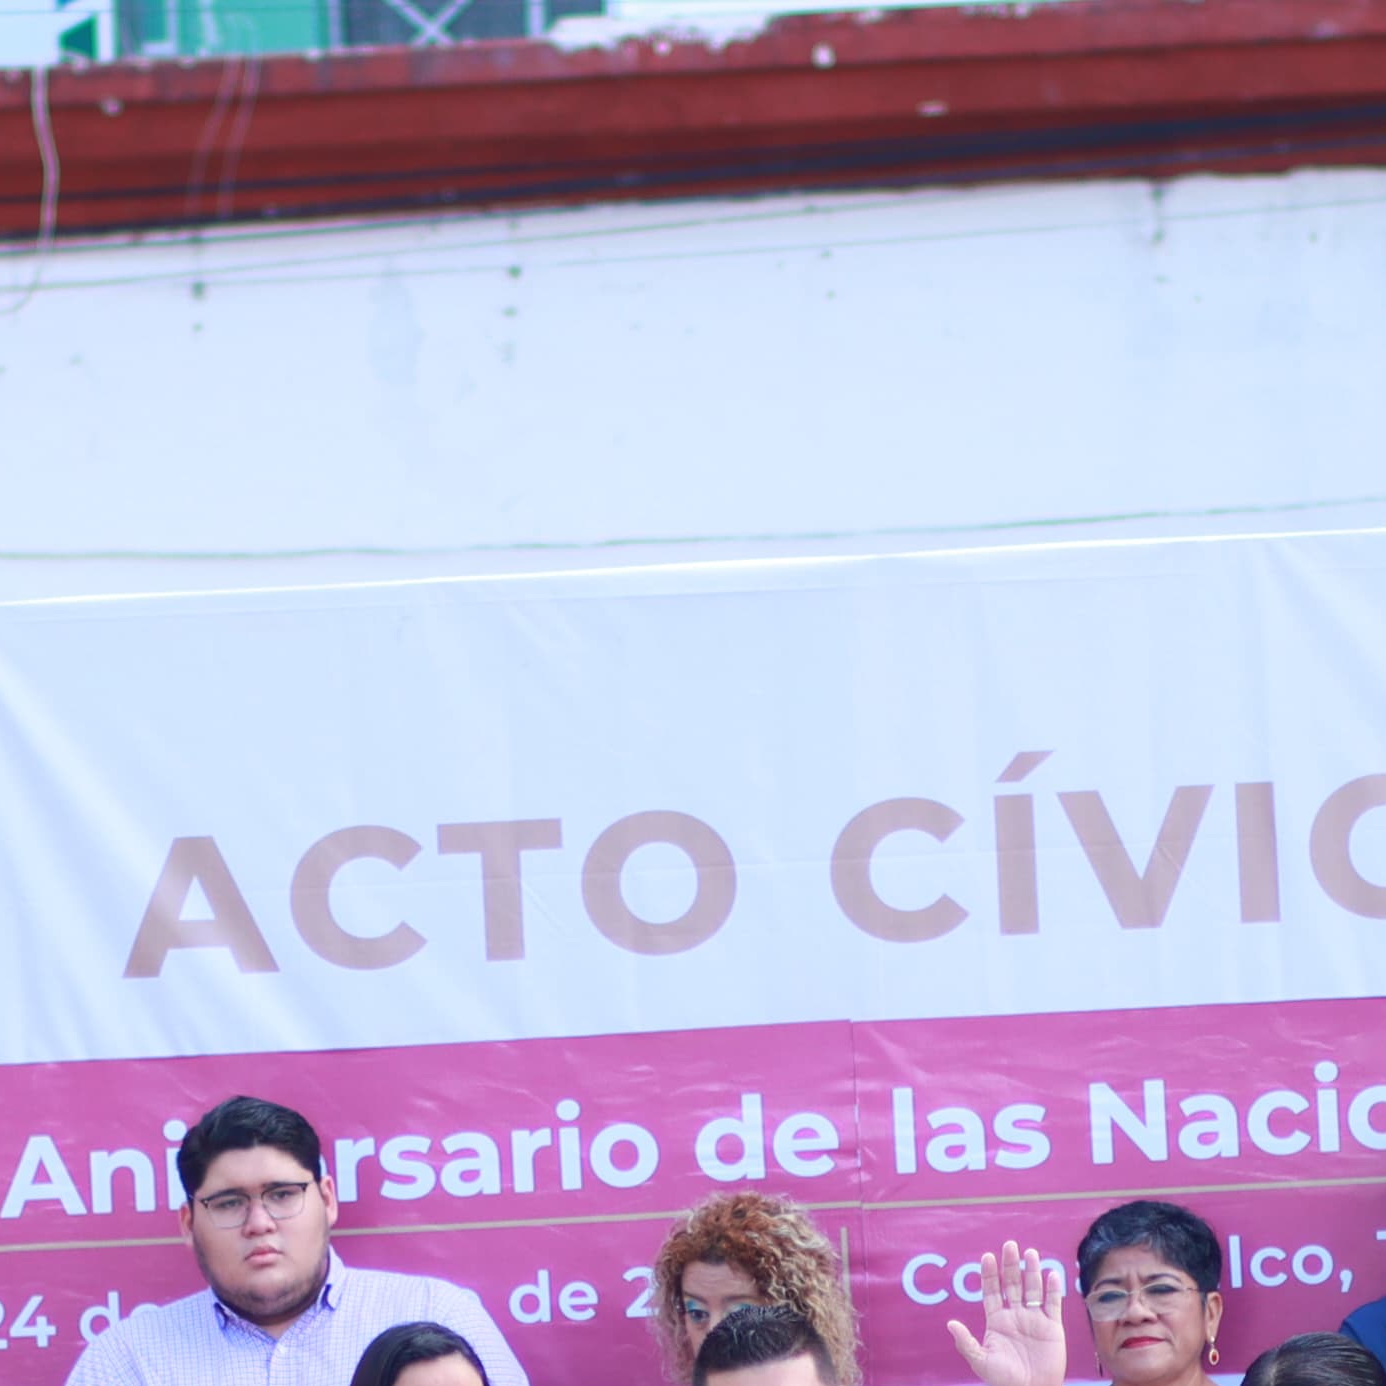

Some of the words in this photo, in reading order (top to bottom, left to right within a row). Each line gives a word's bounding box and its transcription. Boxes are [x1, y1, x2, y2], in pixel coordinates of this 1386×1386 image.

[121, 809, 738, 980] ACTO
[0, 1098, 660, 1219] Anirsario
[694, 1092, 840, 1183] de
[891, 1085, 1052, 1176] las
[509, 1269, 599, 1323] de
